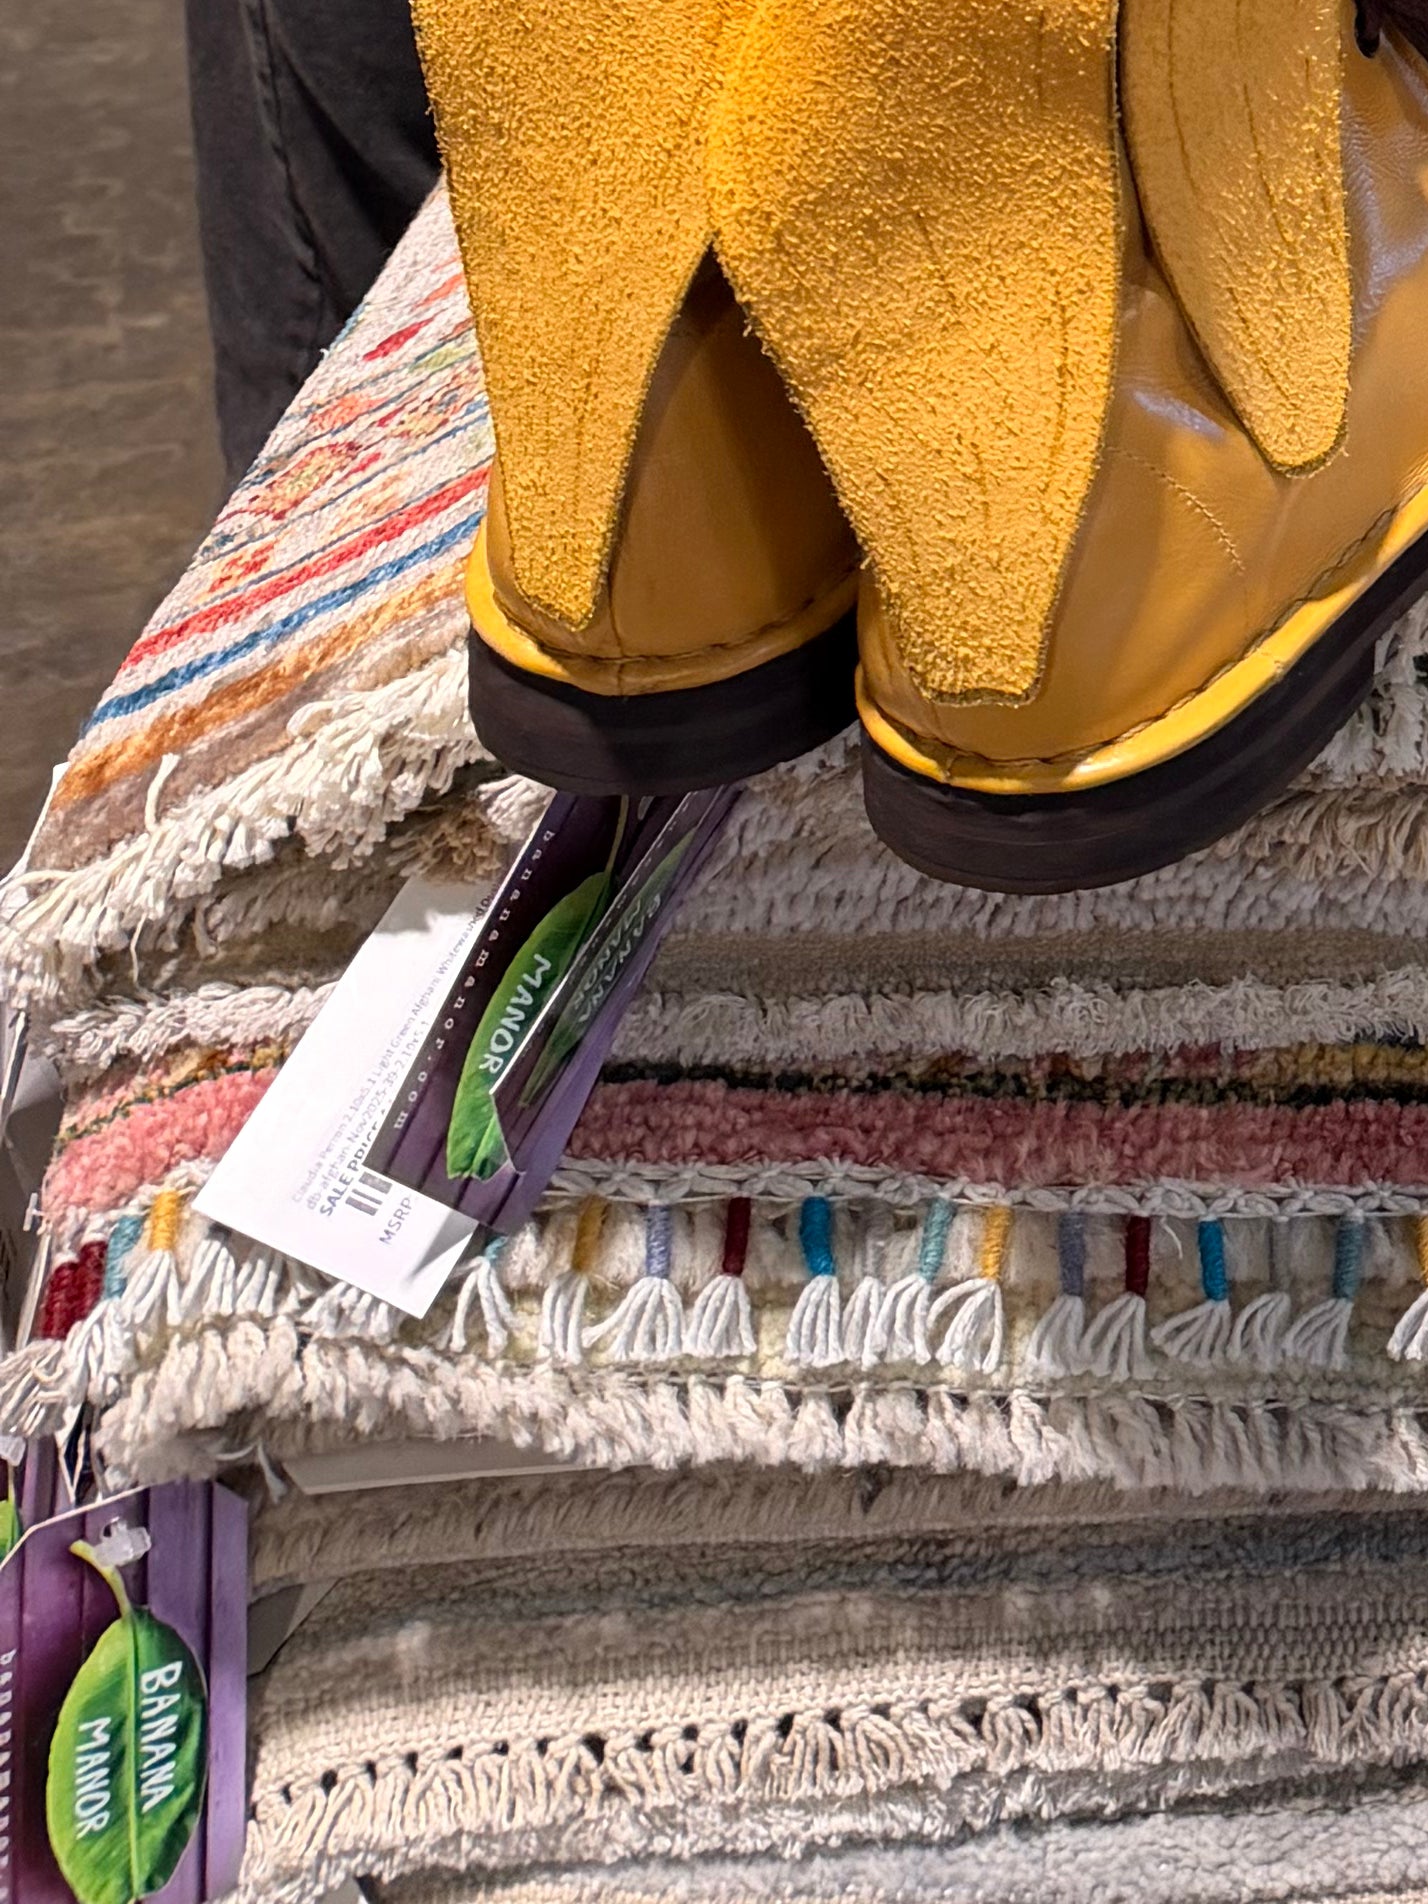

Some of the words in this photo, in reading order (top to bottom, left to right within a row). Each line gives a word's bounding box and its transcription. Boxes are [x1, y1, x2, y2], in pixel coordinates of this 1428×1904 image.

[391, 829, 556, 1134] bananamanor.com
[476, 952, 552, 1076] MANOR
[371, 1047, 395, 1078] Light
[389, 1015, 416, 1050] Green
[317, 1170, 354, 1218] SALE
[377, 1195, 413, 1245] MSRP
[76, 1717, 111, 1841] MANOR
[140, 1661, 183, 1814] BANANA
